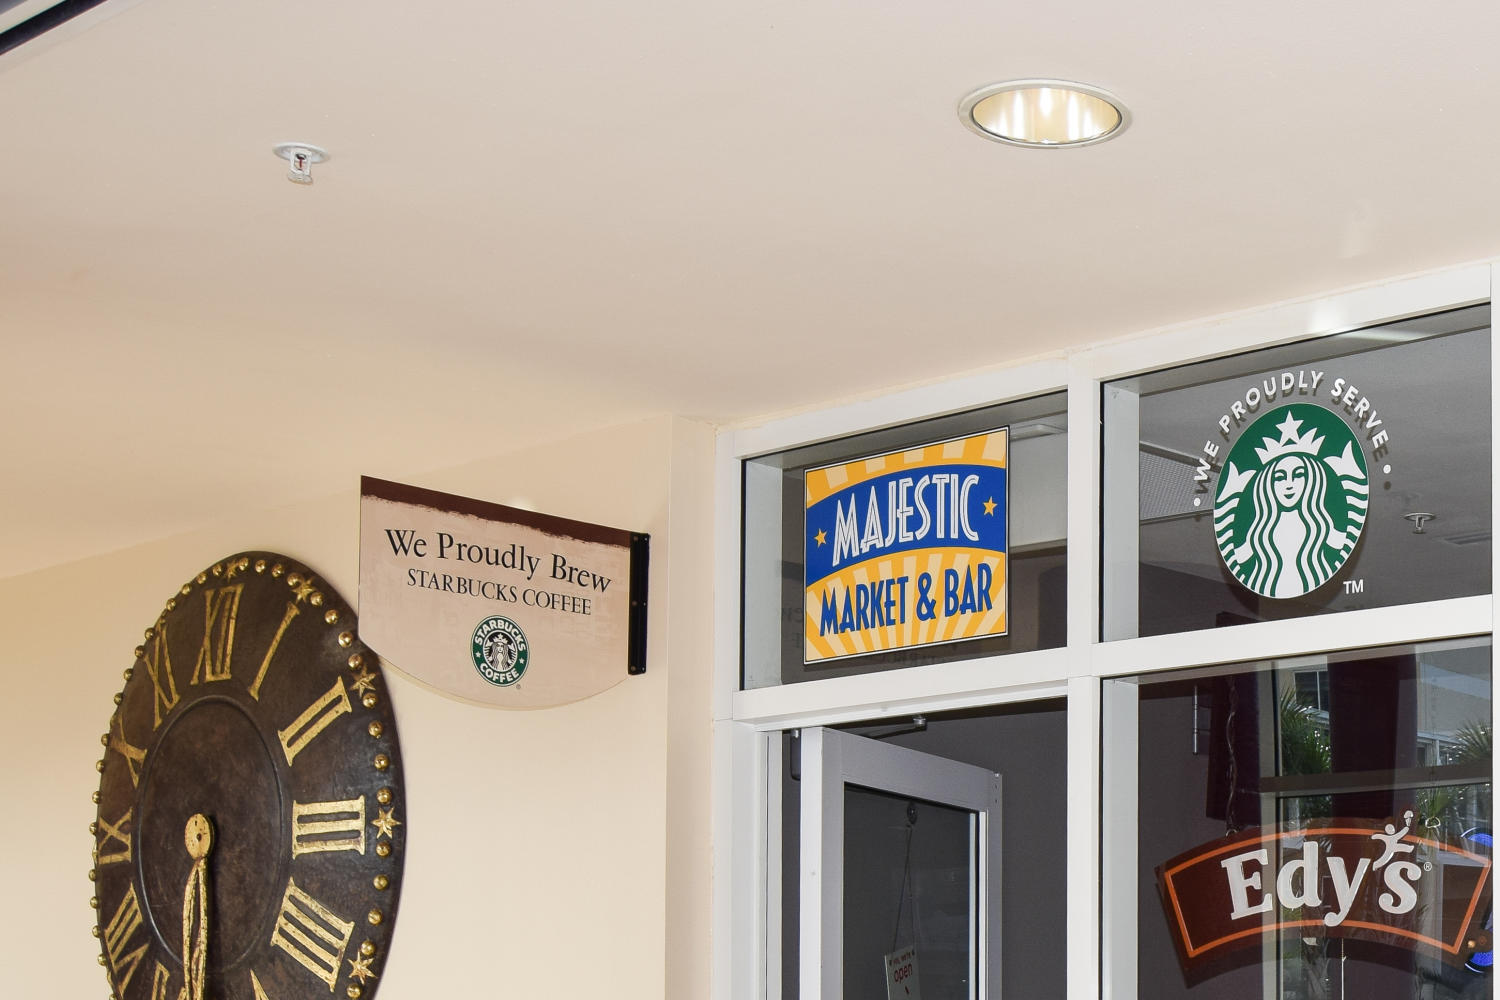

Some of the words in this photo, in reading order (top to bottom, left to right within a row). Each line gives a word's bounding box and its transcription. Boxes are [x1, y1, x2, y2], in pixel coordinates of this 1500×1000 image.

[1194, 440, 1219, 484] WE
[1218, 370, 1324, 433] PROUDLY
[1330, 378, 1389, 450] SERVE
[832, 473, 980, 568] MAJESTIC
[384, 528, 427, 558] We
[436, 531, 541, 580] Proudly
[549, 553, 612, 593] Brew
[1343, 579, 1364, 595] TM
[407, 568, 518, 604] STARBUCKS
[522, 588, 592, 616] COFFEE
[819, 575, 909, 637] MARKET
[917, 572, 936, 621] &
[945, 562, 993, 618] BAR
[474, 619, 526, 652] STARBUCKS
[480, 662, 519, 683] COFFEE
[1221, 830, 1422, 927] Edy's
[894, 963, 913, 984] open
